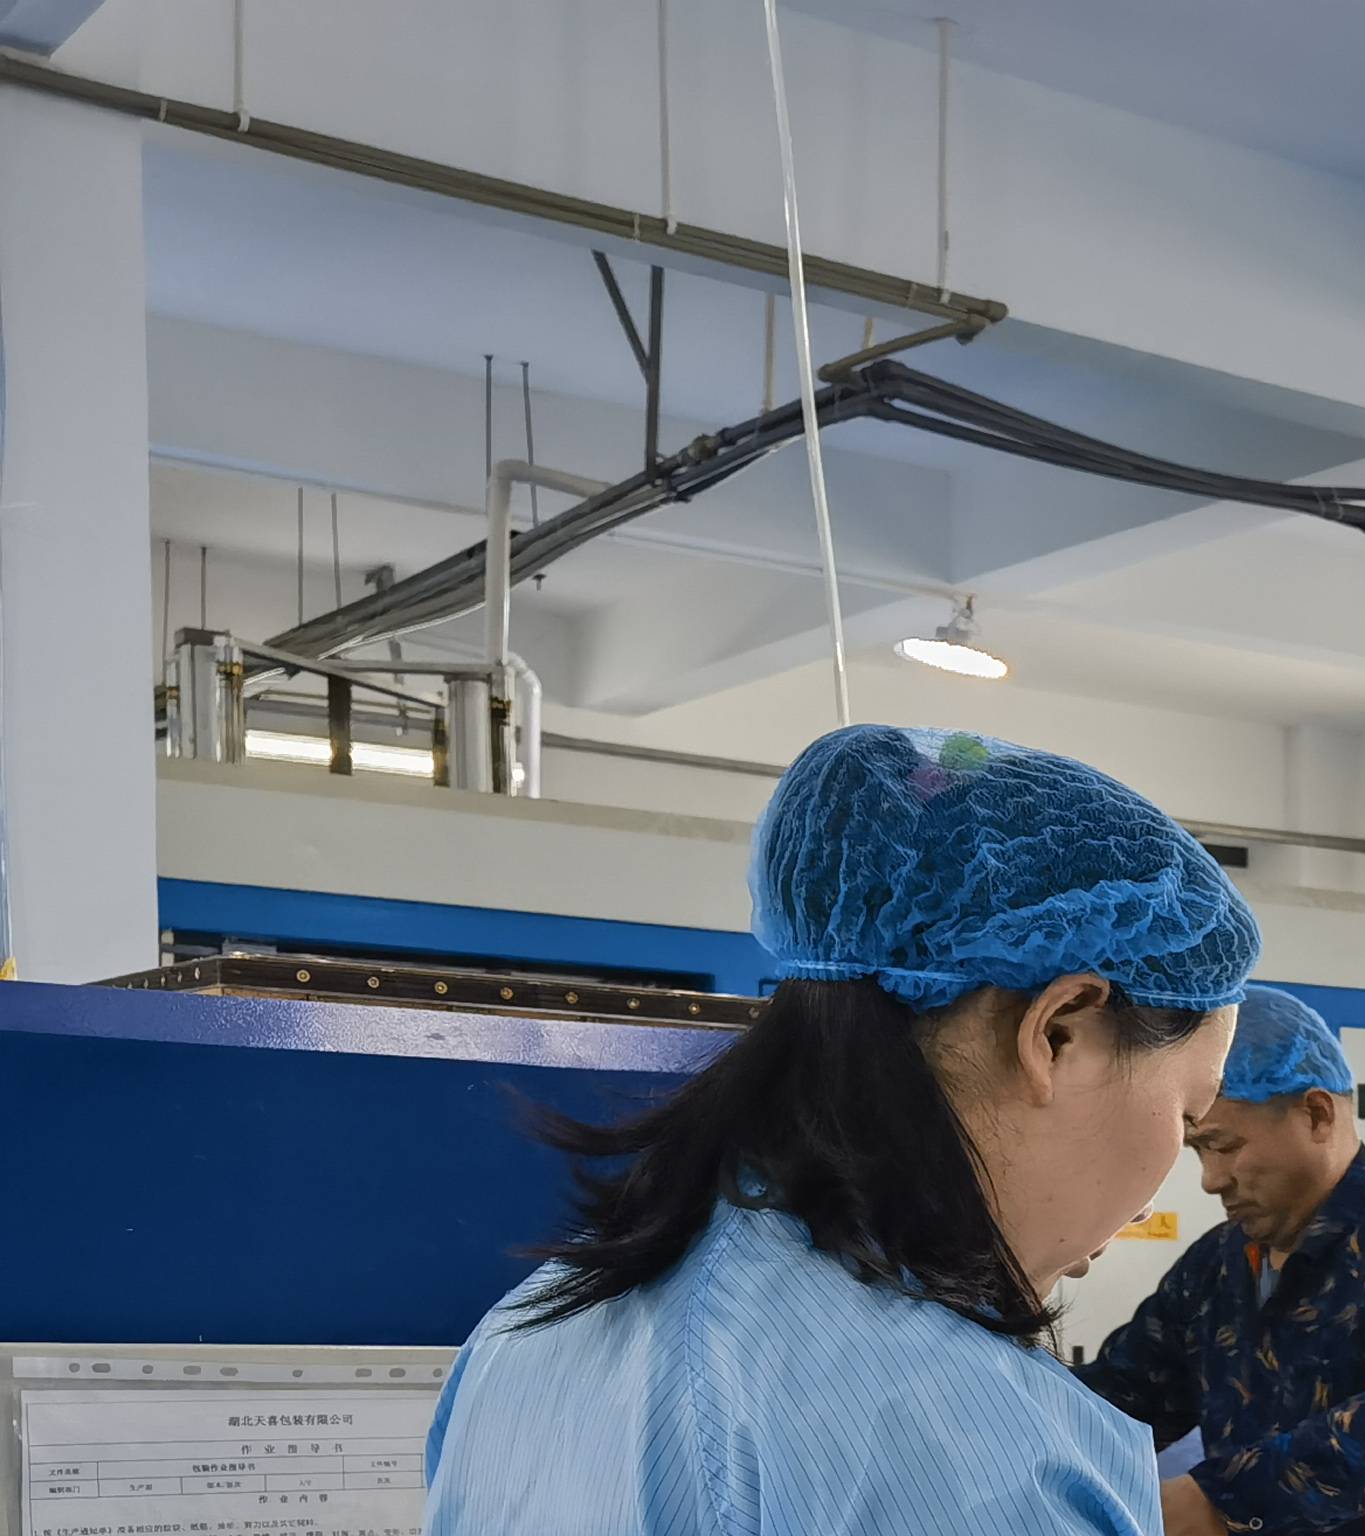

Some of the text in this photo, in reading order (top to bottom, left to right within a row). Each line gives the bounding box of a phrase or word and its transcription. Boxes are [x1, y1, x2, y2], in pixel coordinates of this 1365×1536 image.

[227, 1413, 354, 1427] 湖北天喜包装有限公司
